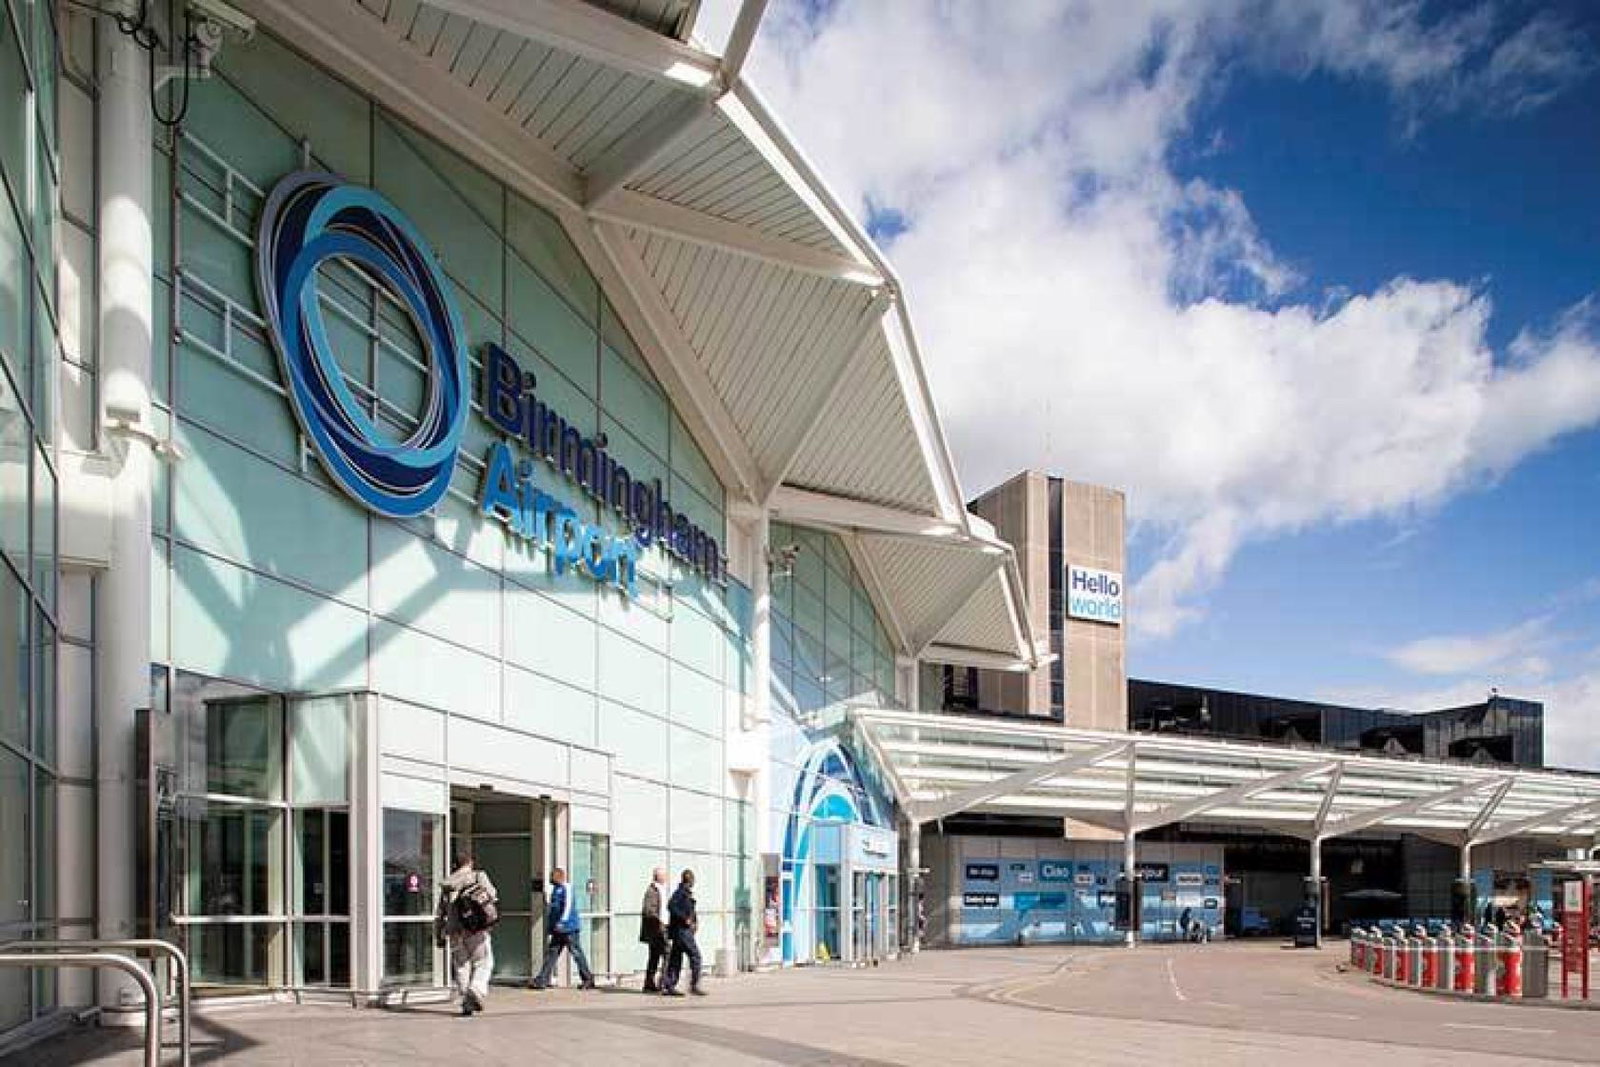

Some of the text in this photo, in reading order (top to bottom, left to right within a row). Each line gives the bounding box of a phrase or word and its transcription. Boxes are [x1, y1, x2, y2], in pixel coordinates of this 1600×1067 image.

[482, 342, 719, 581] Birmingham
[482, 440, 639, 601] Airport
[1072, 569, 1119, 597] Hello
[1072, 598, 1120, 617] world
